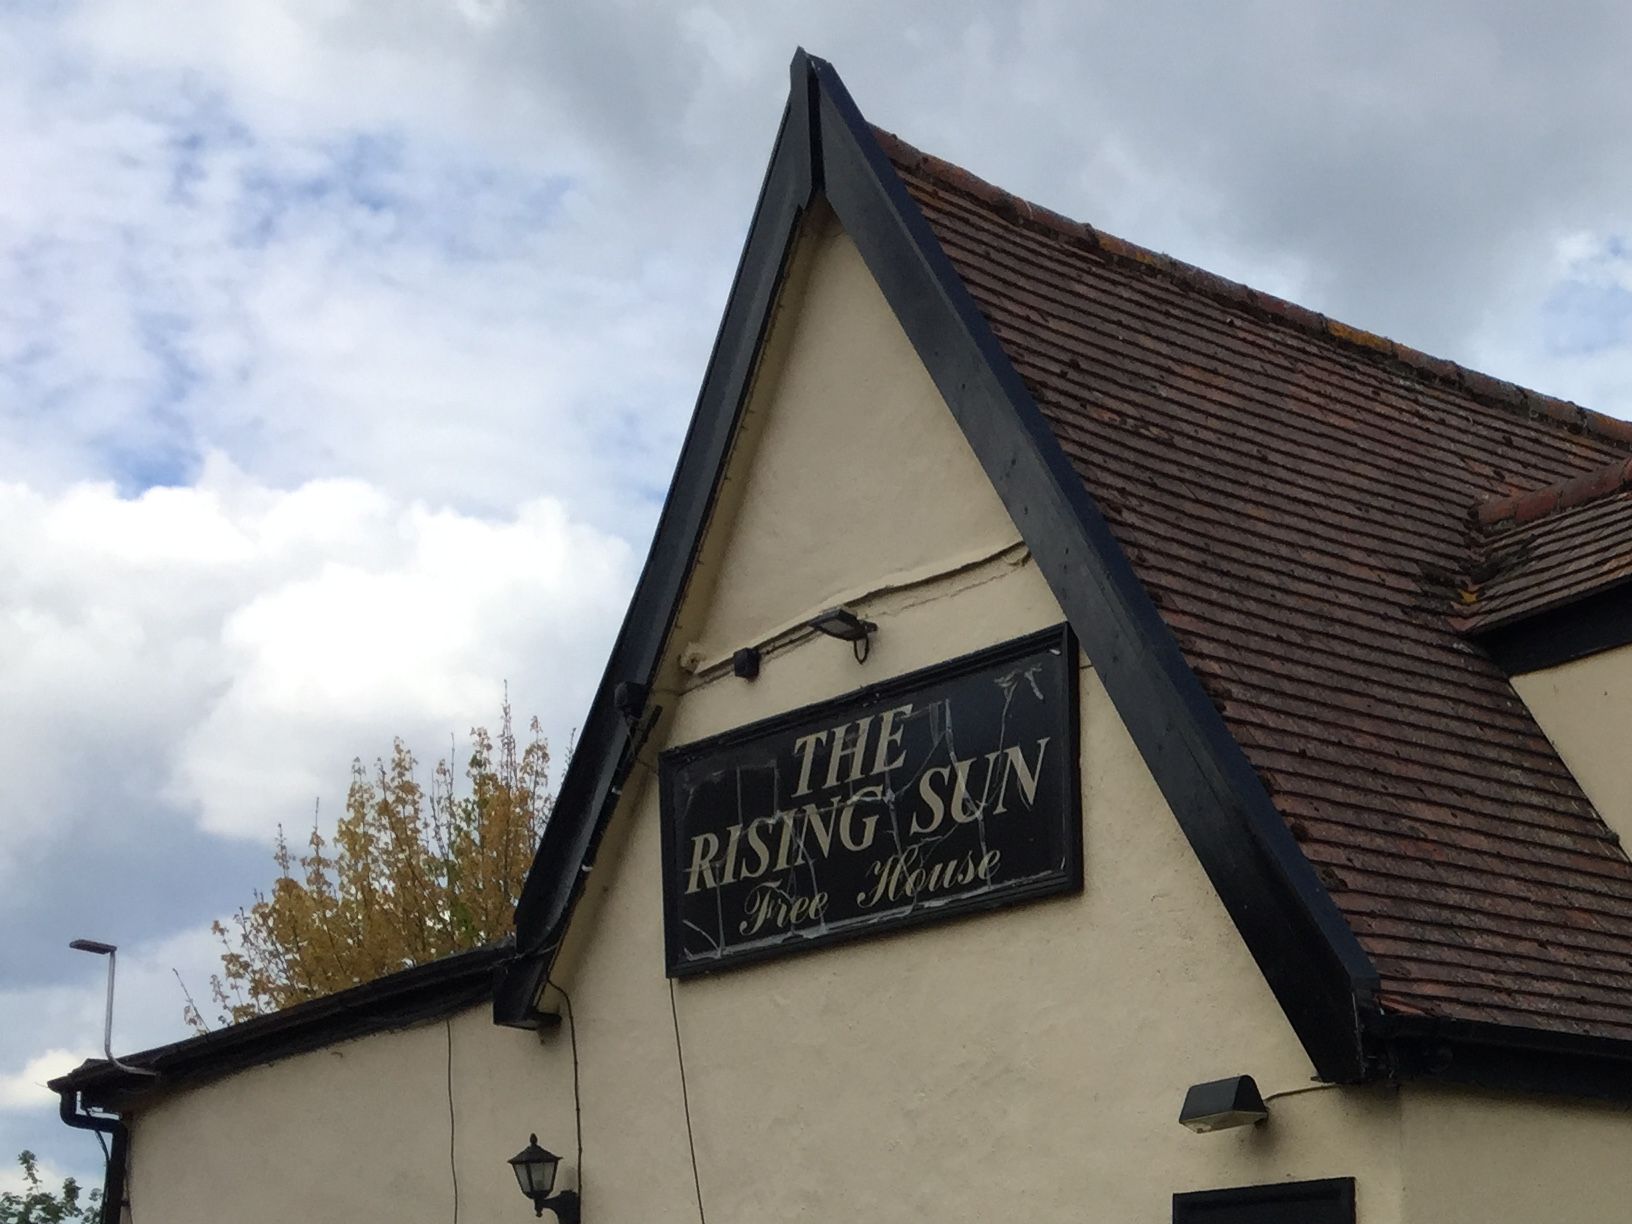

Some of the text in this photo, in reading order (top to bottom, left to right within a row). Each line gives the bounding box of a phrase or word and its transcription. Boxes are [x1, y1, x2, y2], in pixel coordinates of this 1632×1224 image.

[793, 703, 914, 798] THE
[684, 737, 1050, 895] RISING SUN
[739, 846, 1001, 936] Free House
